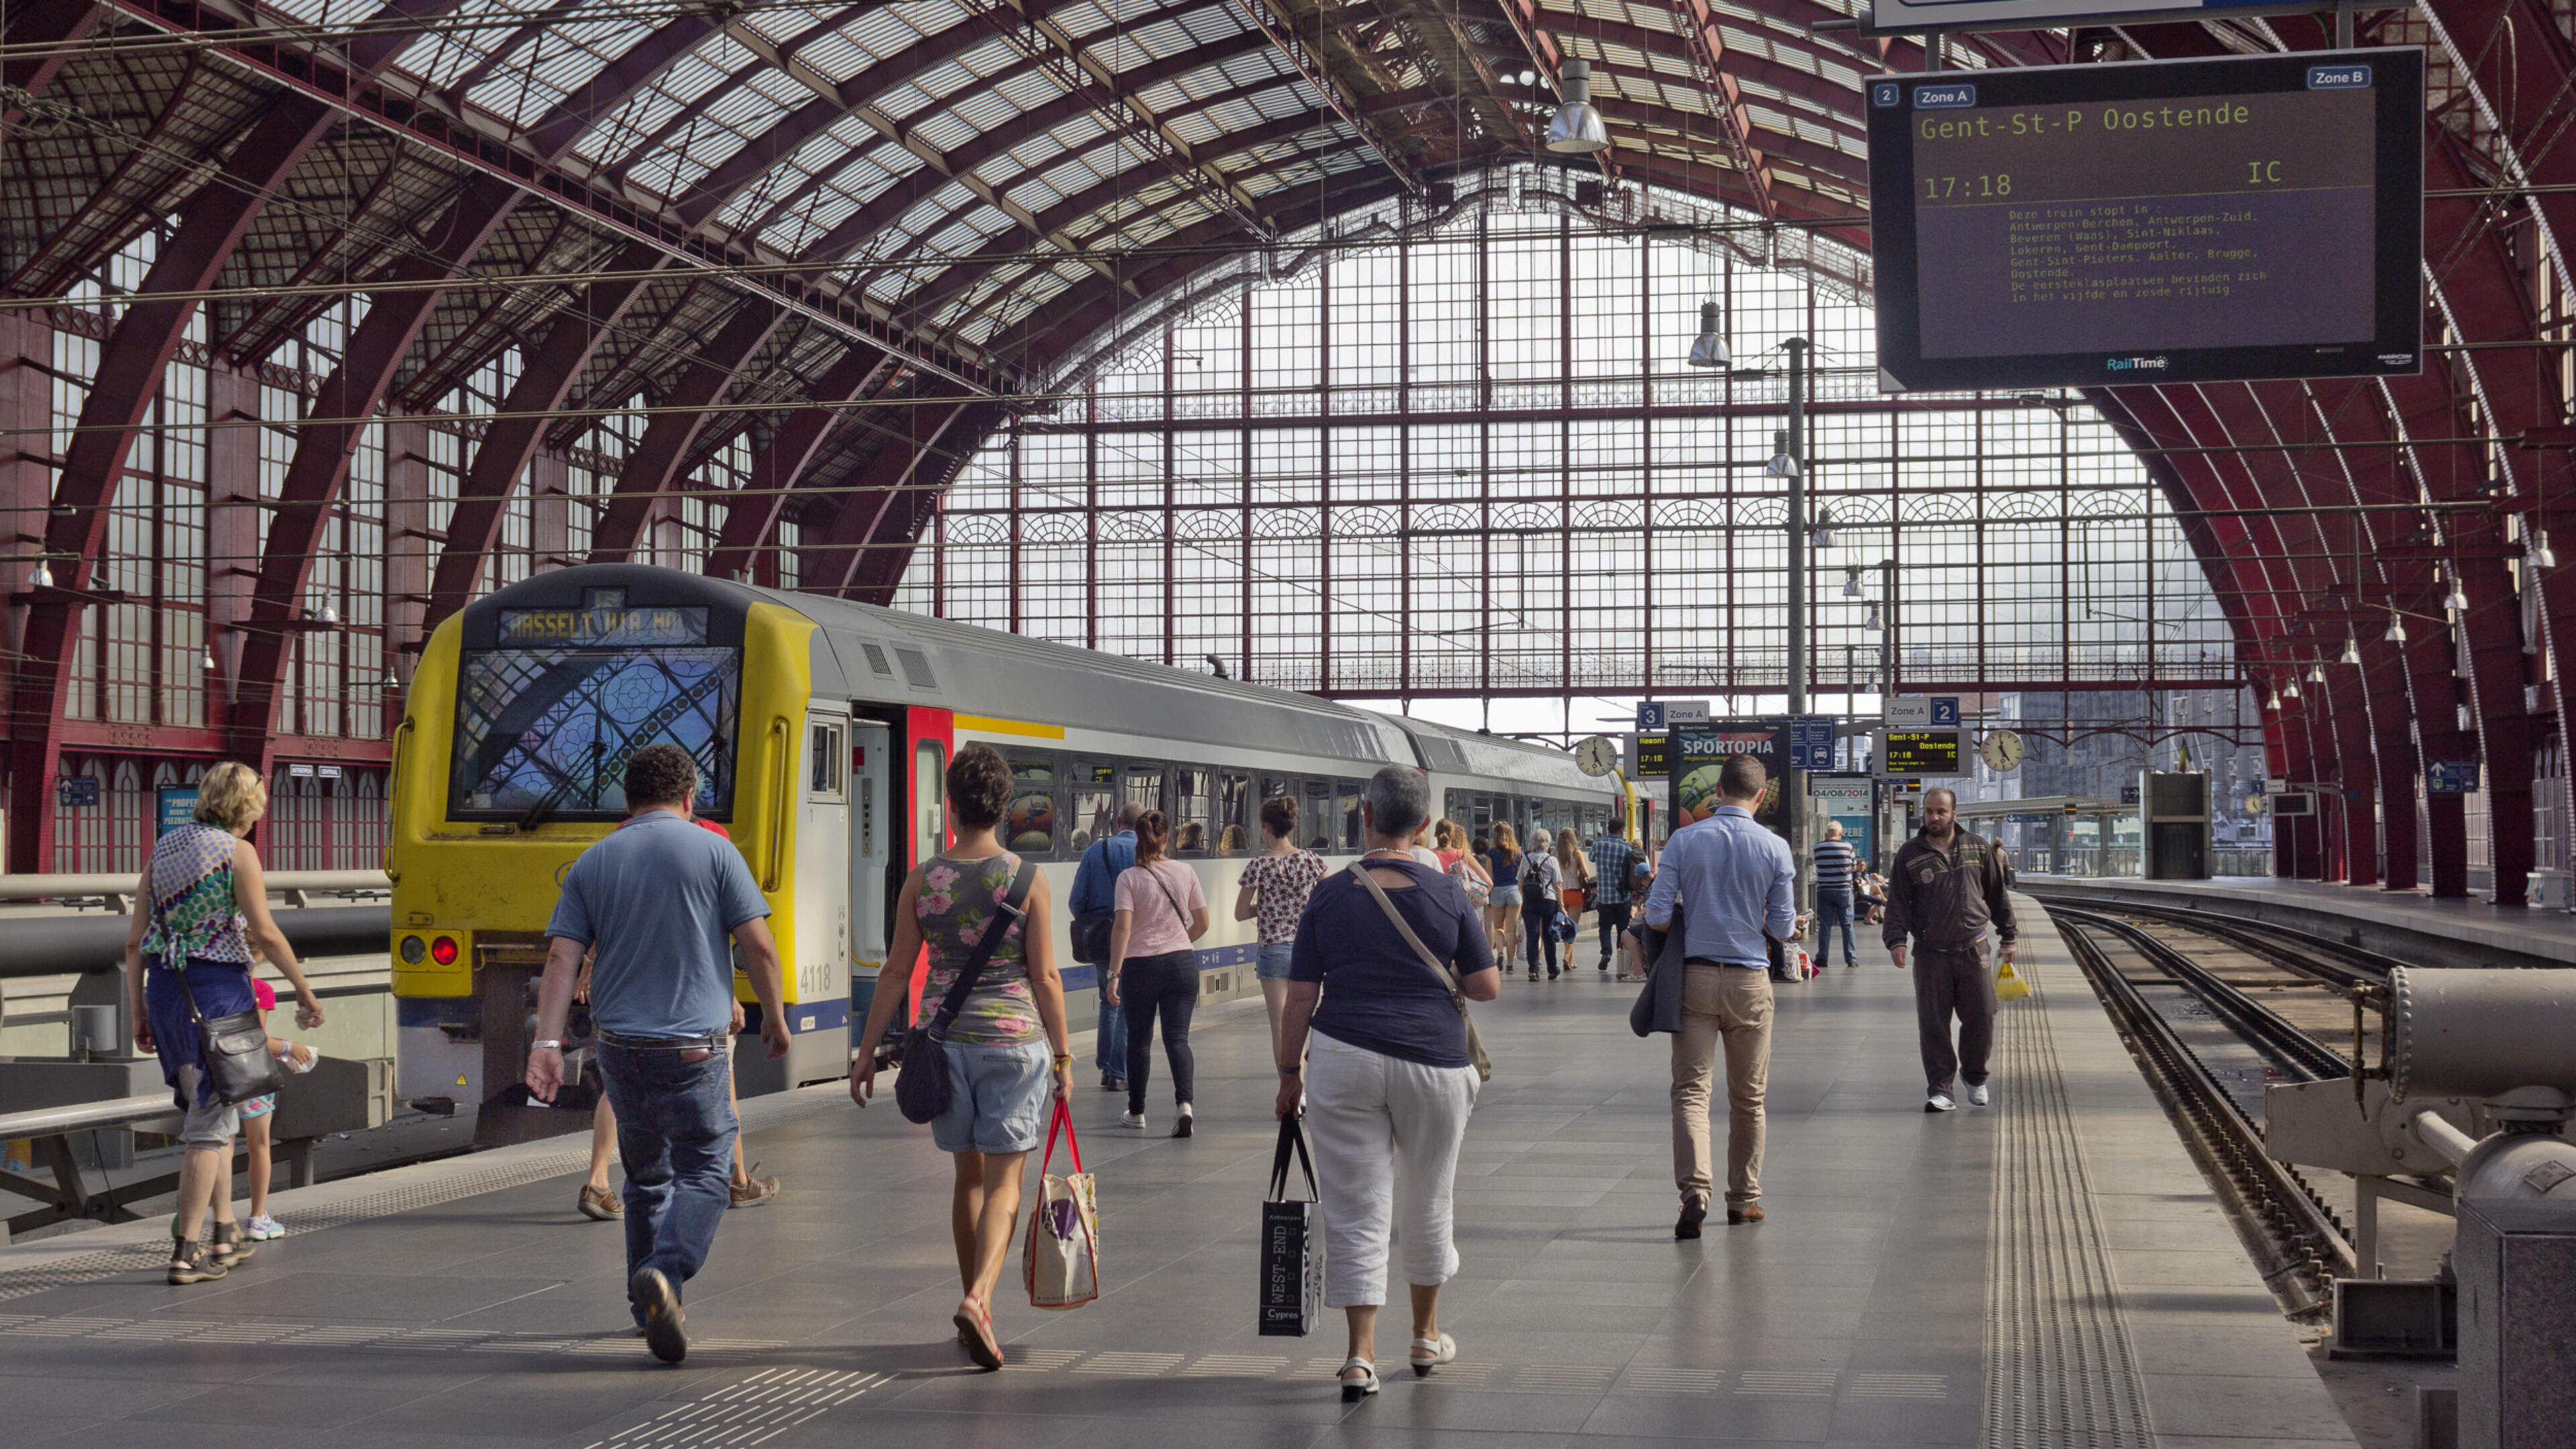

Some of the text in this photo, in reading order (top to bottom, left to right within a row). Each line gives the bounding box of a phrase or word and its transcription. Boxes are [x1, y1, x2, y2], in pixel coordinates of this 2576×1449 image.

[2316, 70, 2363, 84] Zone B
[1882, 90, 1890, 101] 2
[1922, 91, 1968, 103] Zone A
[1921, 102, 2249, 139] Gent-St-P Oostende
[1925, 160, 2282, 199] 17:18 IC
[2009, 210, 2038, 220] Deze
[2045, 209, 2082, 218] trein
[2090, 205, 2125, 216] stopt
[2133, 204, 2148, 215] in
[2010, 233, 2061, 244] Beveren
[2011, 281, 2026, 290] De
[2171, 273, 2231, 284] bevinden
[2238, 271, 2267, 282] zich
[2012, 292, 2027, 302] in
[2033, 292, 2055, 302] het
[2062, 290, 2106, 301] vijfde
[2113, 289, 2128, 299] en
[2135, 286, 2171, 297] zesde
[2106, 357, 2165, 370] RailTime
[1646, 710, 1656, 724] 3
[1670, 710, 1703, 718] Zone A
[1890, 706, 1925, 715] Zone A
[1939, 706, 1950, 720] 2
[1683, 740, 1774, 754] SPORTOPIA
[1889, 751, 1912, 759] 17:18
[1813, 789, 1868, 797] 04/08/2014
[1842, 827, 1864, 837] PERE
[800, 963, 832, 994] 4118
[1271, 1225, 1287, 1303] WEST-END
[1267, 1308, 1299, 1320] Cypres
